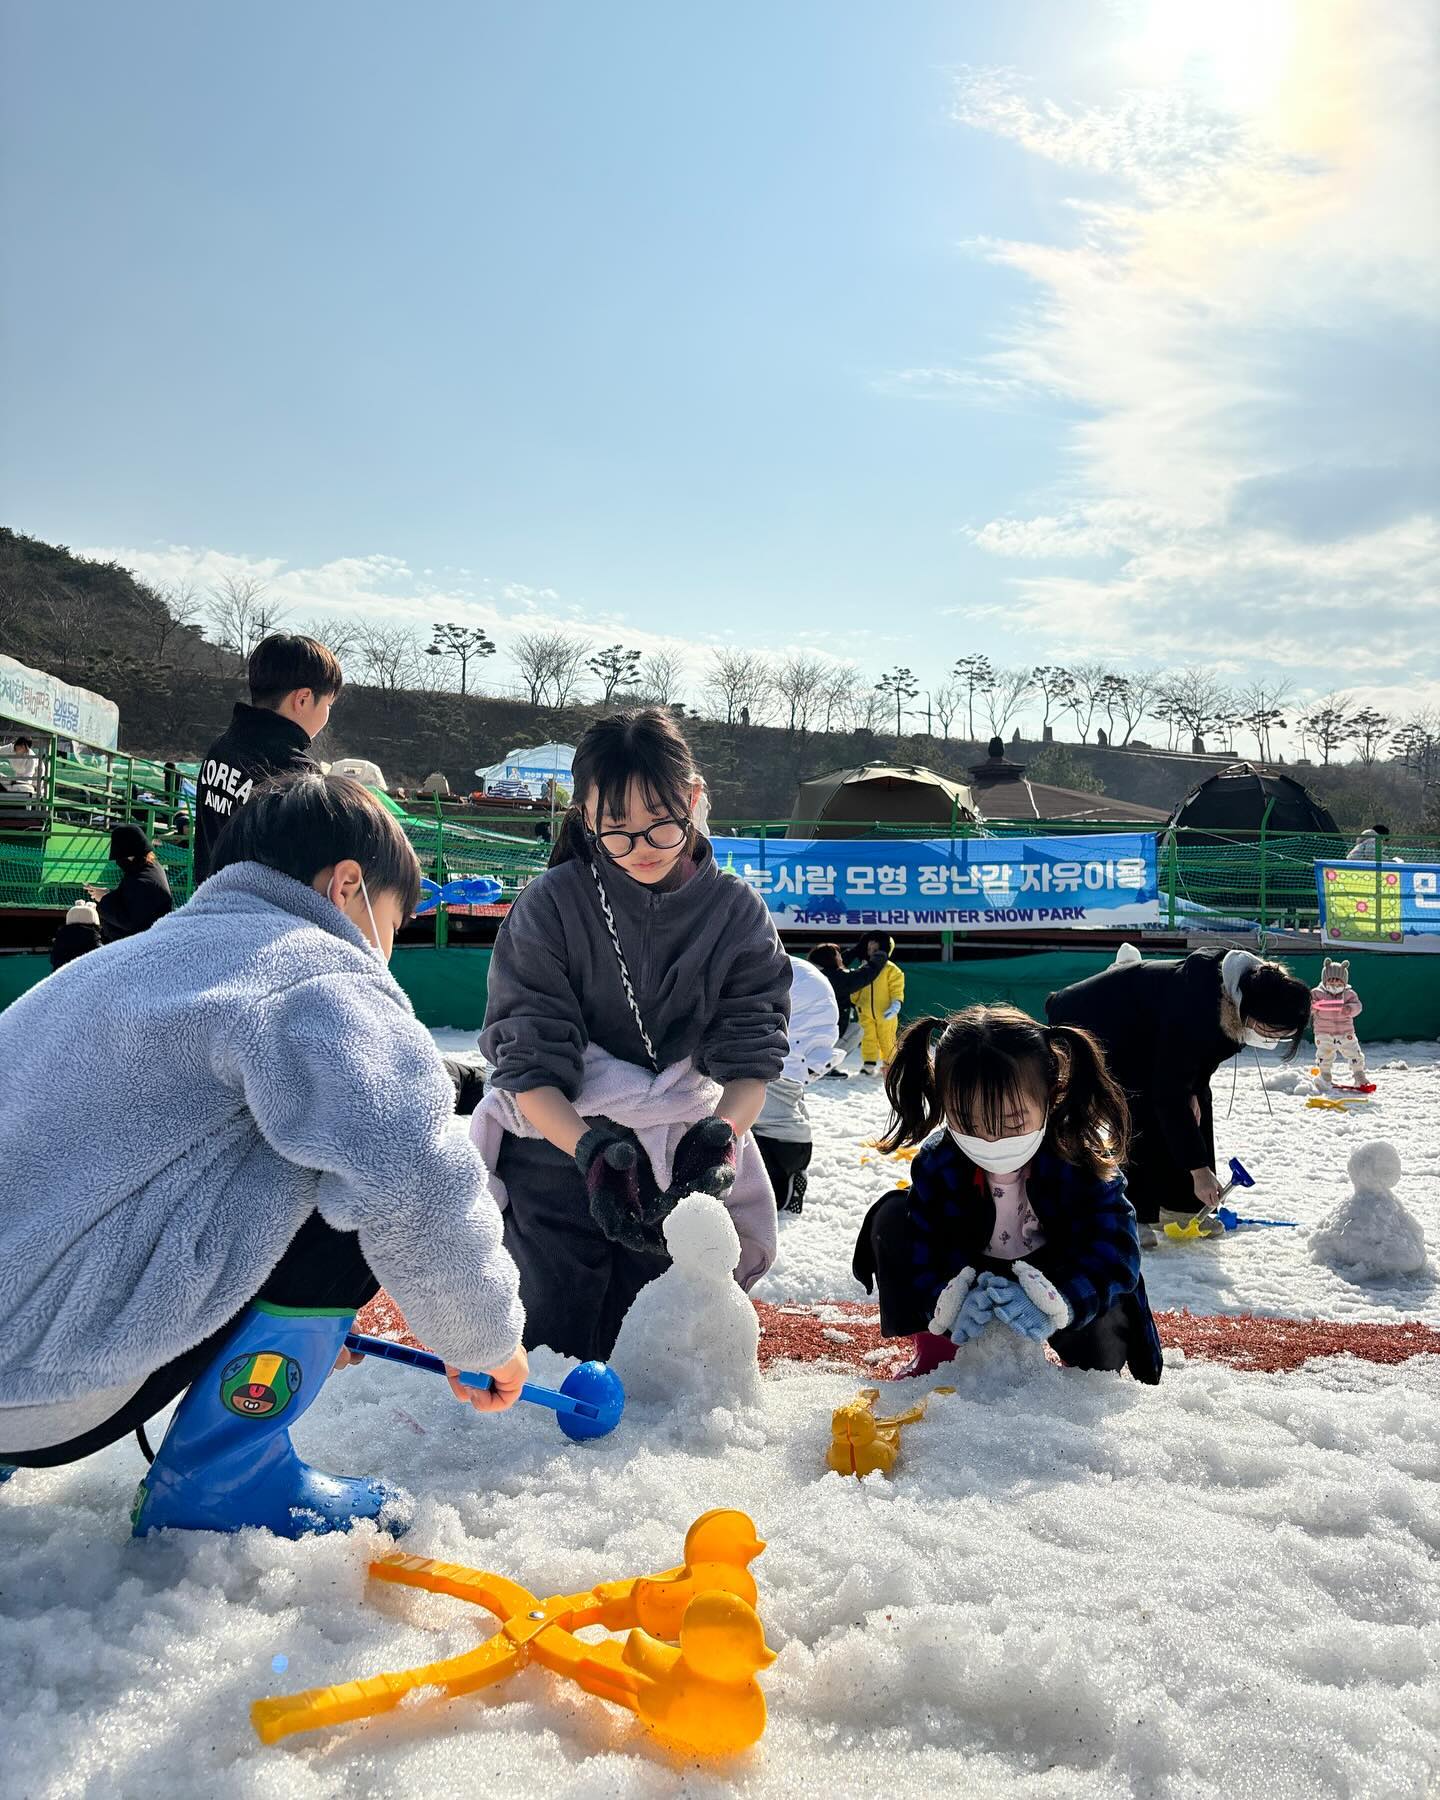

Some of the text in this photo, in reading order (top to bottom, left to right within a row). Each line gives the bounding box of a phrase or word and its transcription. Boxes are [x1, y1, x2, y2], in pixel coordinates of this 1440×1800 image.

[0, 676, 24, 712] 체험
[743, 858, 1147, 896] 눈사람 모형 장난감 자유이용
[913, 909, 980, 924] WINTER
[984, 908, 1034, 923] SNOW
[1039, 906, 1087, 922] PARK
